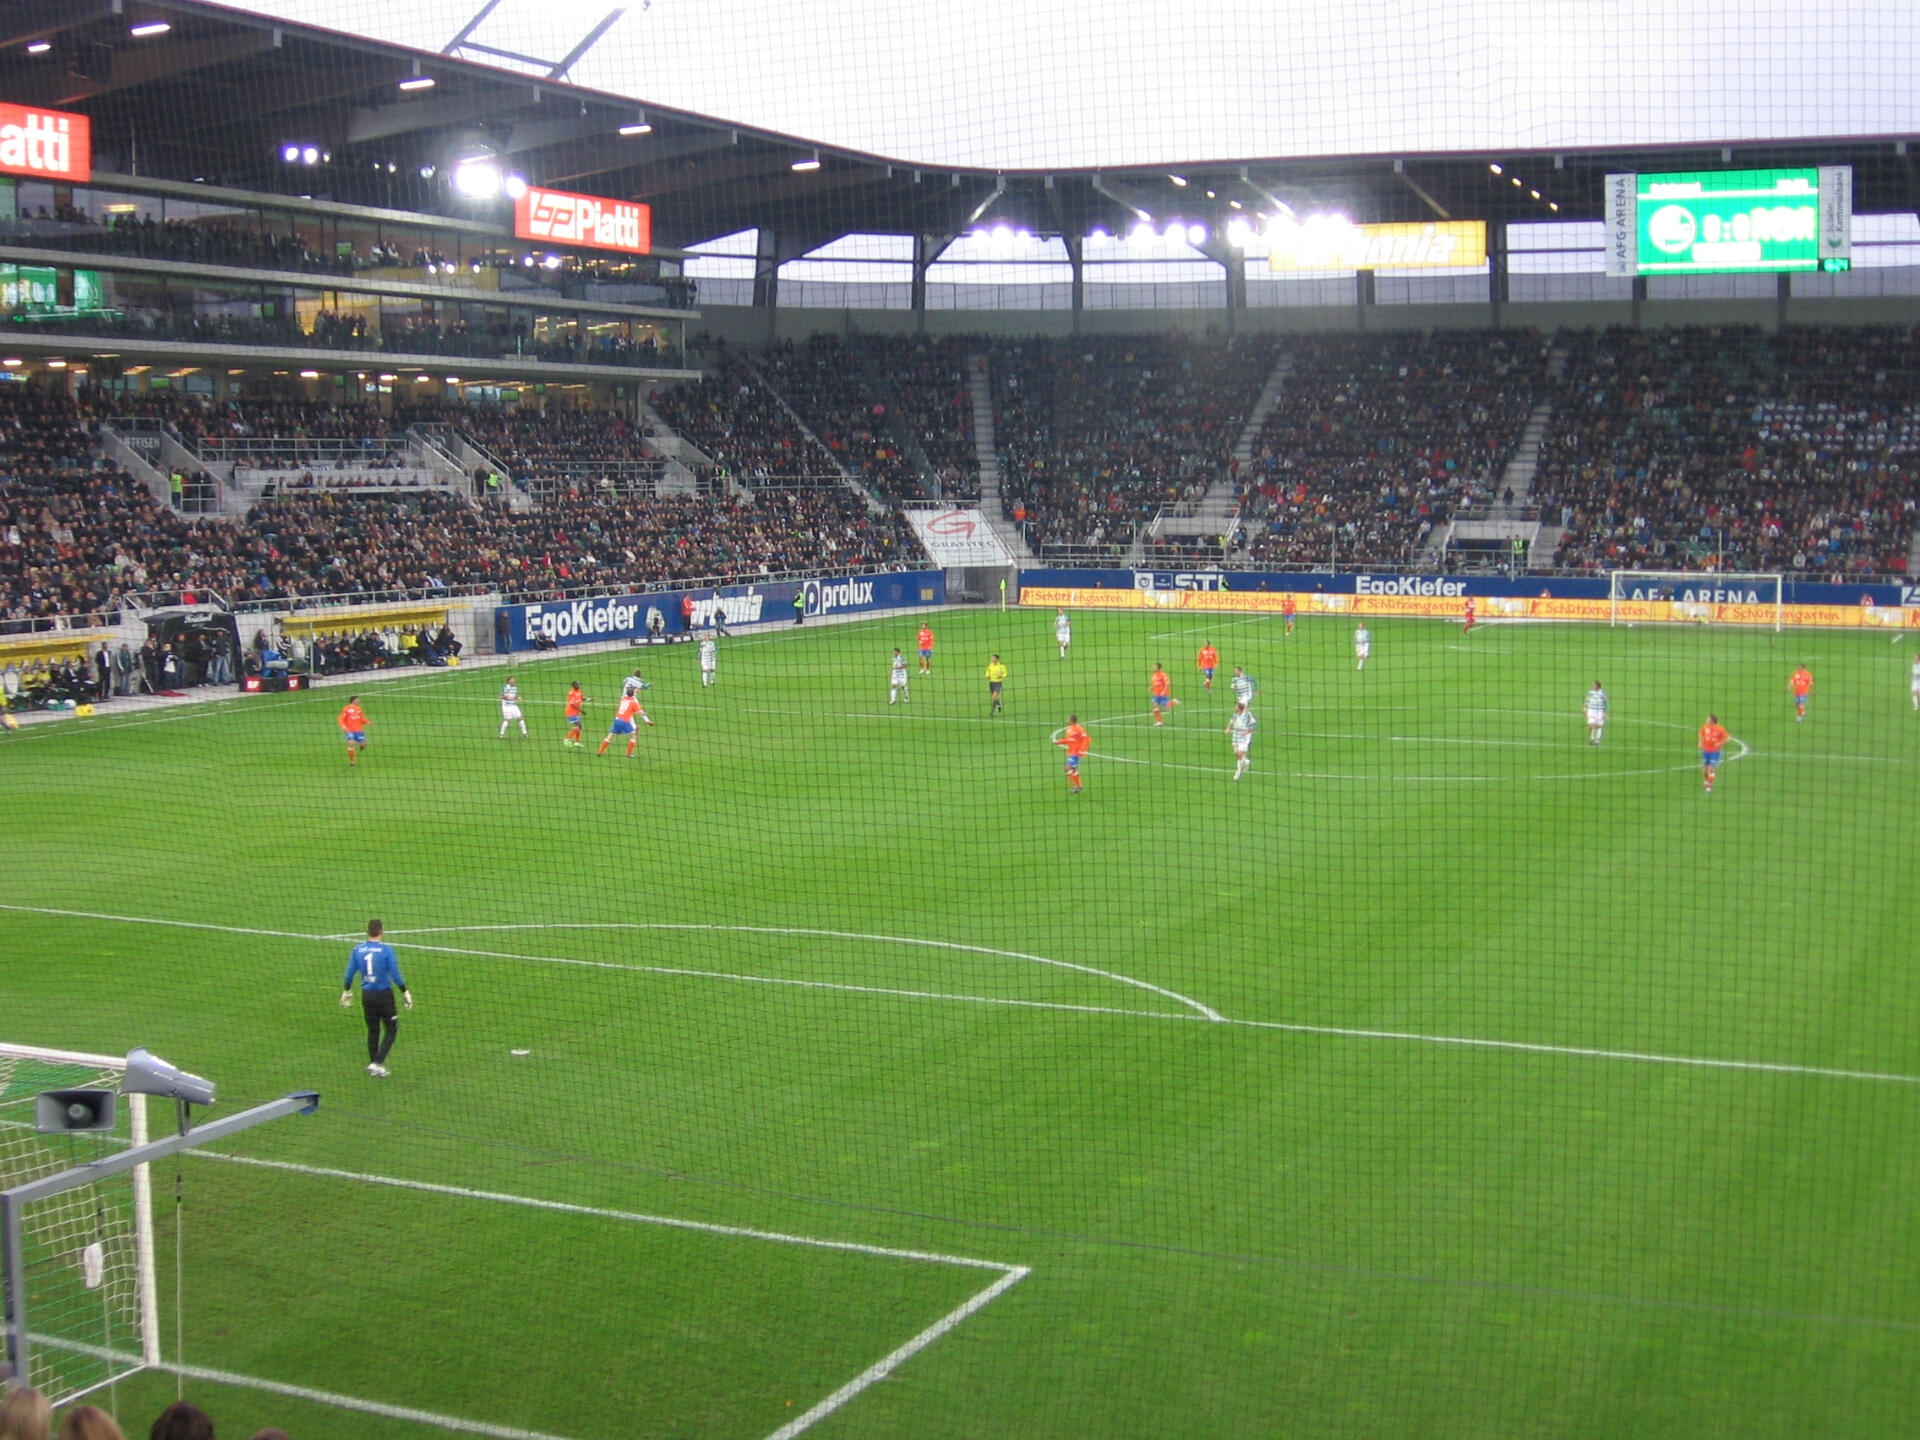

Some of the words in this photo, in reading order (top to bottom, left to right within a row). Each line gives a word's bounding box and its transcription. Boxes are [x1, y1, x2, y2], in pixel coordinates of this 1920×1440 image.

[1615, 177, 1626, 227] ARENA
[576, 197, 639, 248] Piatti
[1615, 231, 1626, 259] AFG
[930, 540, 995, 548] GRAFITEC
[822, 577, 873, 615] prolux
[1355, 575, 1467, 596] EgoKiefer
[1632, 588, 1675, 601] AF
[1682, 588, 1759, 604] ARENA
[525, 598, 638, 641] EgoKiefer
[364, 952, 374, 976] 1
